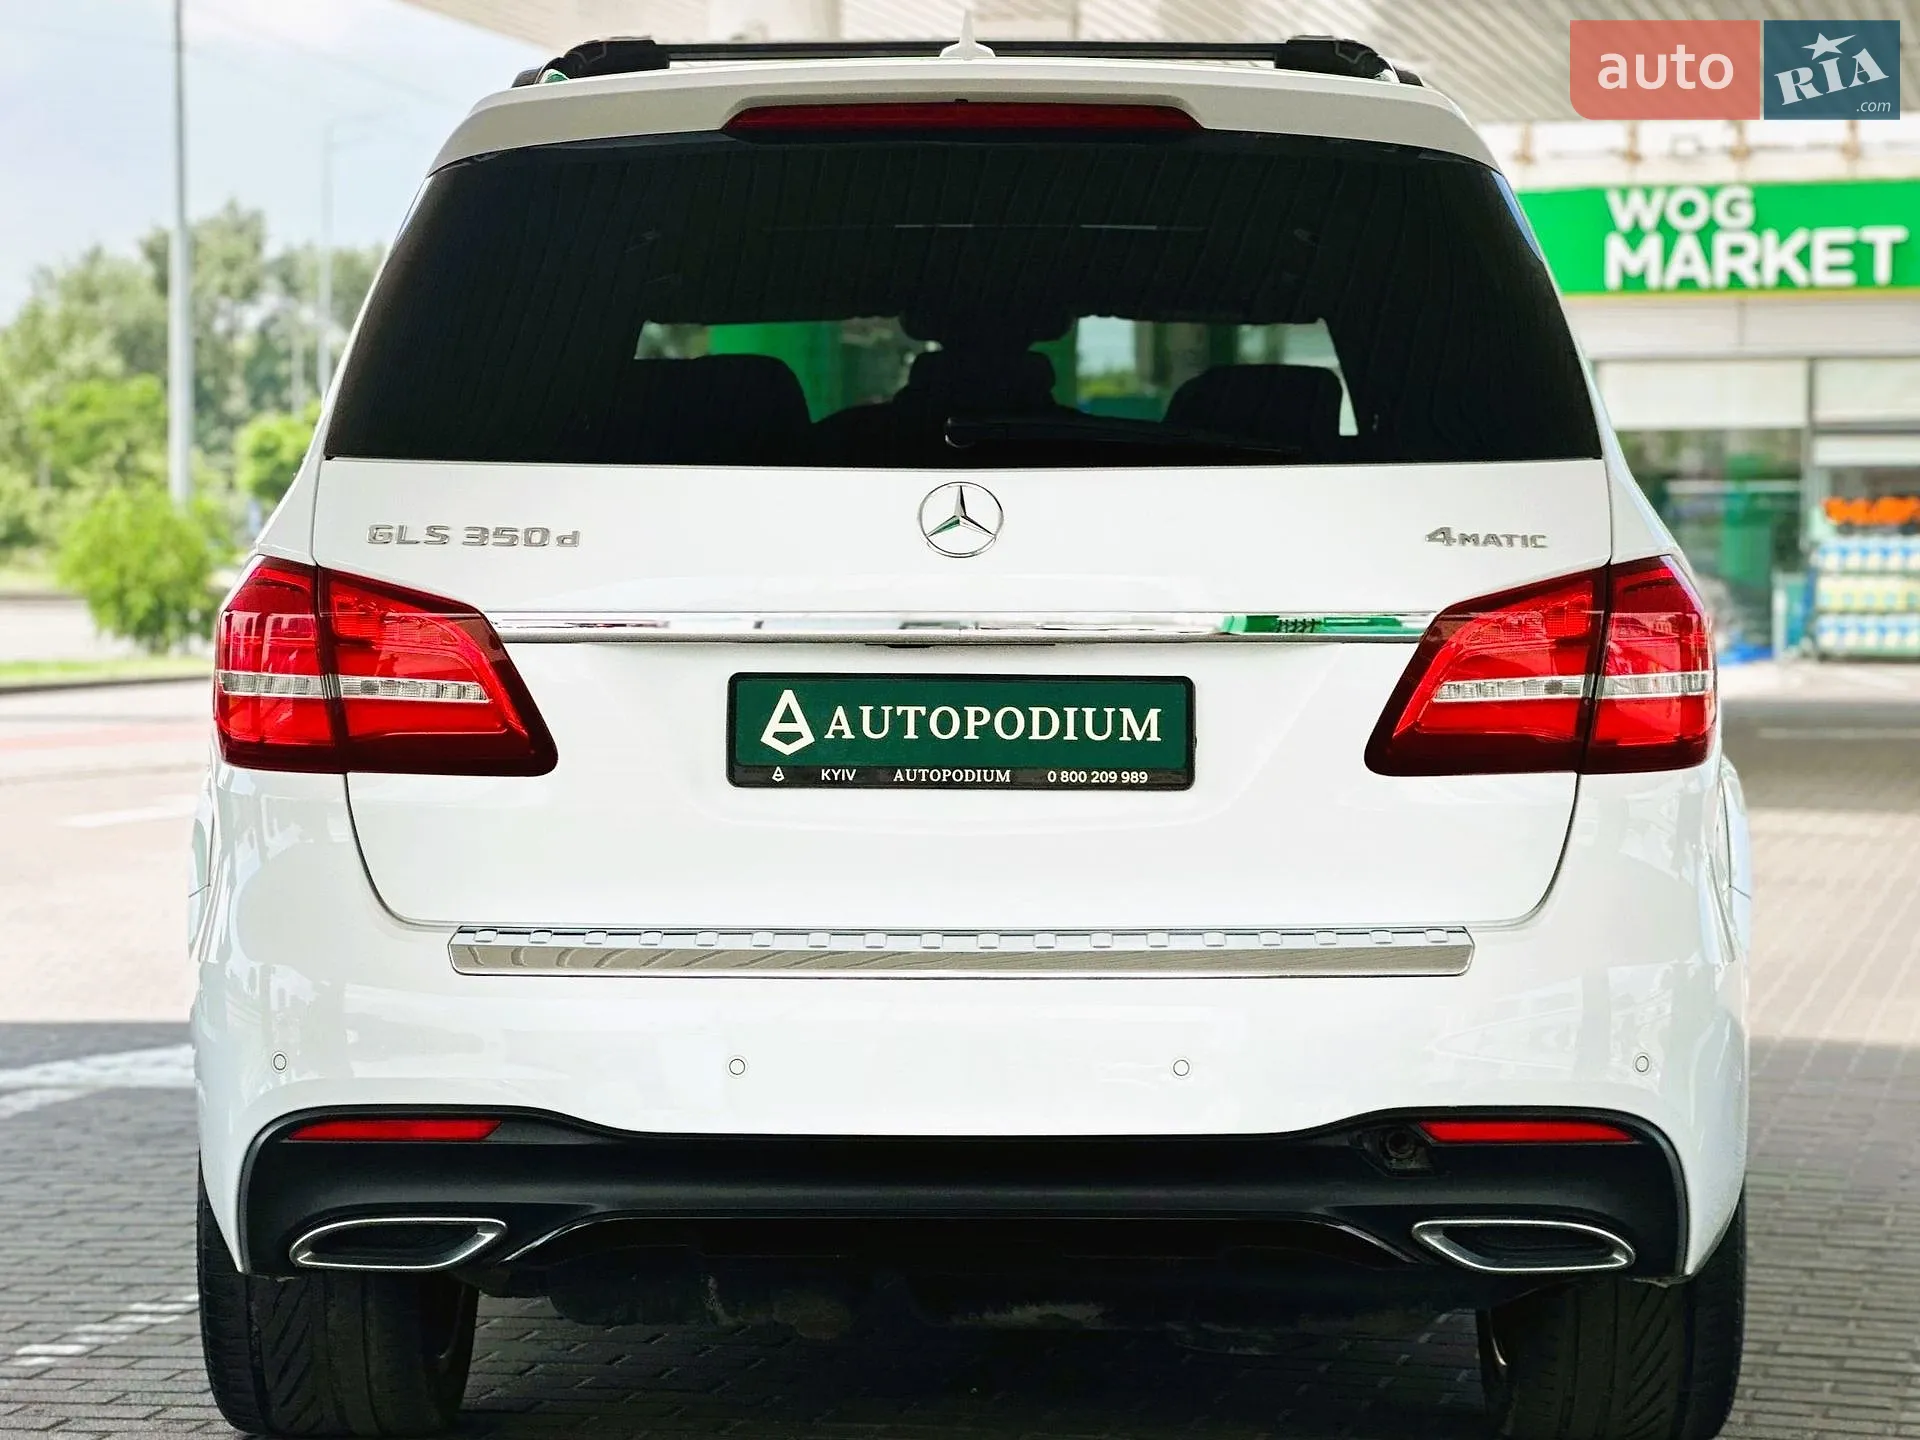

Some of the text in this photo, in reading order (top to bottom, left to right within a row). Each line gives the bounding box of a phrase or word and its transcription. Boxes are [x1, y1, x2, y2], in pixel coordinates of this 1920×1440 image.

[1606, 186, 1756, 231] WOG
[1604, 226, 1909, 291] MARKET
[367, 524, 451, 546] GLS
[462, 526, 550, 547] 350
[1425, 526, 1548, 549] 4MATIC
[824, 705, 1162, 741] AUTOPODIUM
[821, 769, 856, 781] KYIV
[893, 768, 1011, 783] AUTOPODIUM
[1047, 770, 1148, 784] 0 800 209 989
